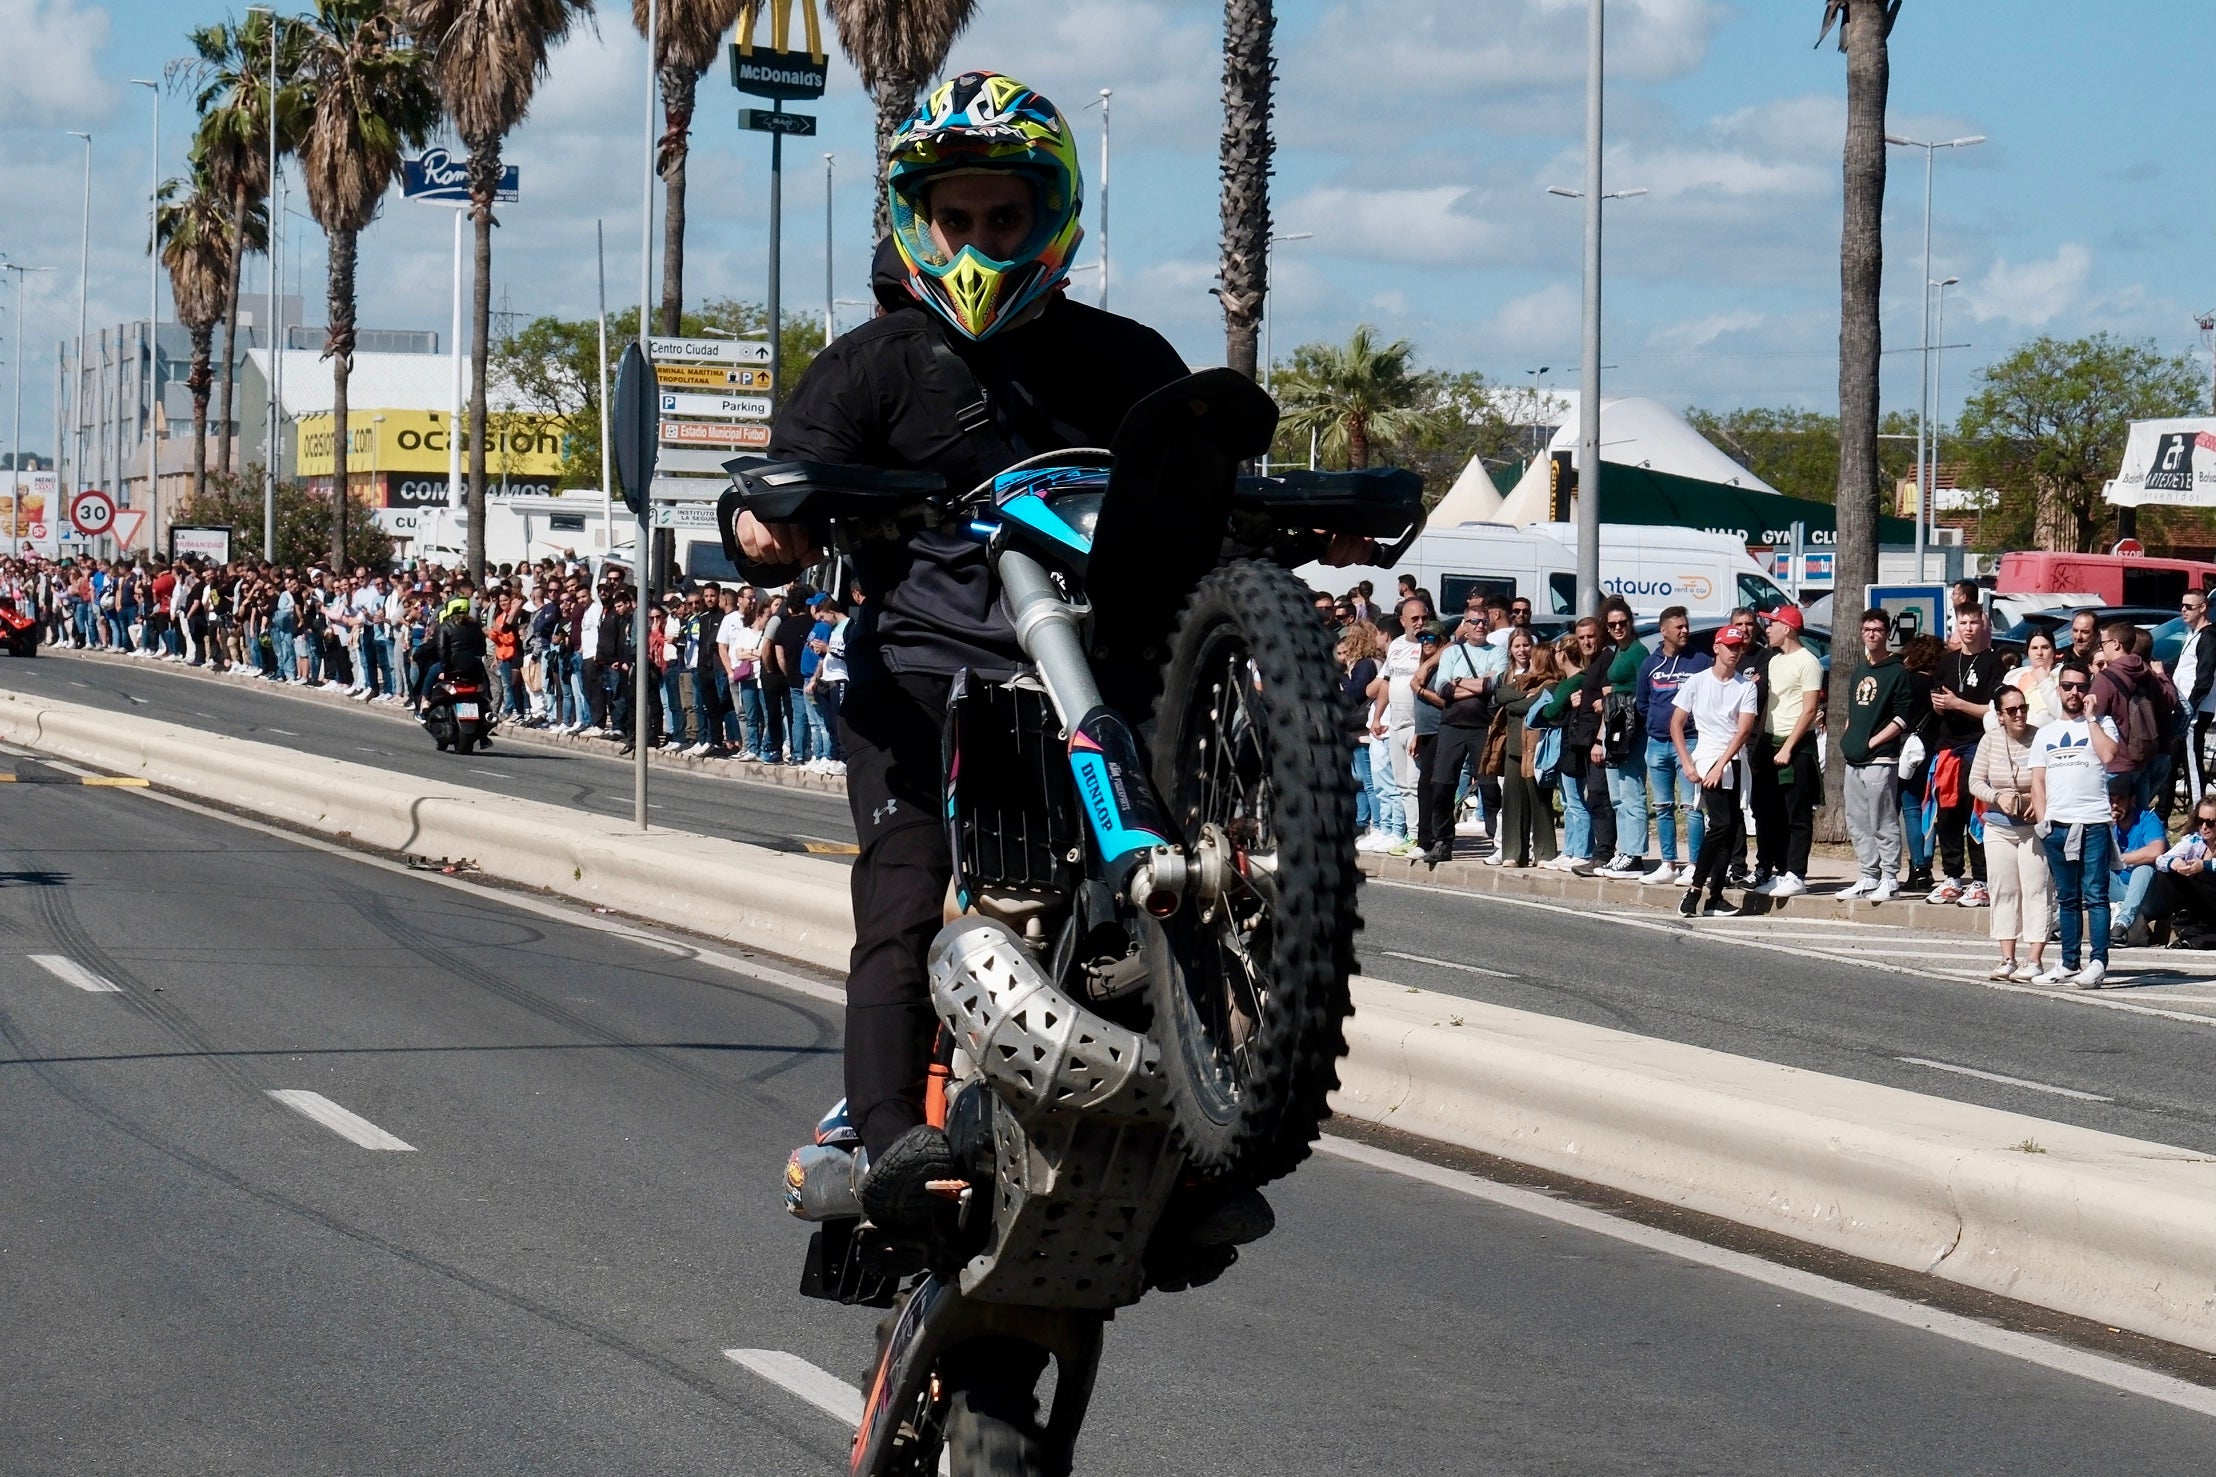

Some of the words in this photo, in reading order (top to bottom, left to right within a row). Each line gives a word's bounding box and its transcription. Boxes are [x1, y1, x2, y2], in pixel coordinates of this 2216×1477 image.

[740, 63, 822, 87] McDonald's
[651, 342, 683, 354] Centro
[685, 344, 719, 356] Ciudad
[656, 367, 685, 375] RMINAL
[658, 375, 710, 385] TROPOLITANA
[722, 400, 765, 415] Parking
[680, 425, 707, 438] Estadio
[708, 427, 742, 440] Municipal
[397, 429, 573, 460] ocasion
[400, 480, 549, 500] COMPAMOS
[80, 505, 106, 521] 30
[677, 509, 715, 517] INSTITUTO
[396, 517, 416, 528] CU
[176, 541, 225, 549] HUMANIDAD
[2117, 550, 2143, 558] STOP
[1603, 577, 1672, 596] ntauro
[1081, 762, 1113, 831] DUNLOP
